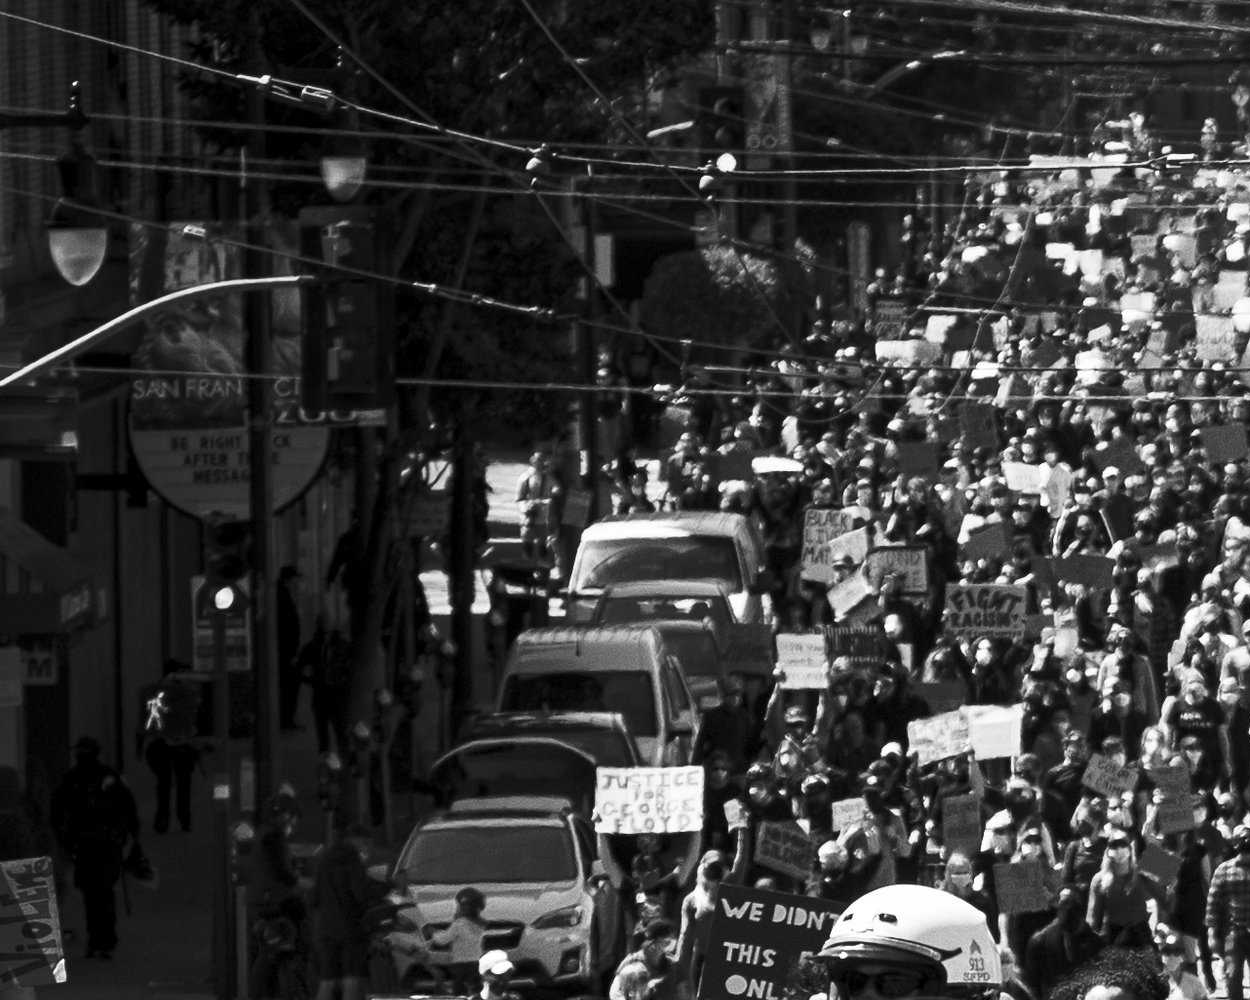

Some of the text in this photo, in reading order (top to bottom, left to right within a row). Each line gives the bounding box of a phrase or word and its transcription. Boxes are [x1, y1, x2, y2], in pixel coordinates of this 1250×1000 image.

[133, 379, 180, 399] SAN
[194, 470, 251, 483] MESSAG
[802, 546, 832, 564] MAT
[950, 588, 1022, 614] FIGHT
[601, 770, 700, 790] JUSTICE
[634, 787, 667, 802] FOR
[602, 799, 697, 817] GEORGE
[614, 814, 691, 833] FLOYD
[721, 897, 765, 922] WE
[723, 941, 778, 968] THIS
[969, 957, 985, 971] 913
[963, 972, 991, 982] SFPD
